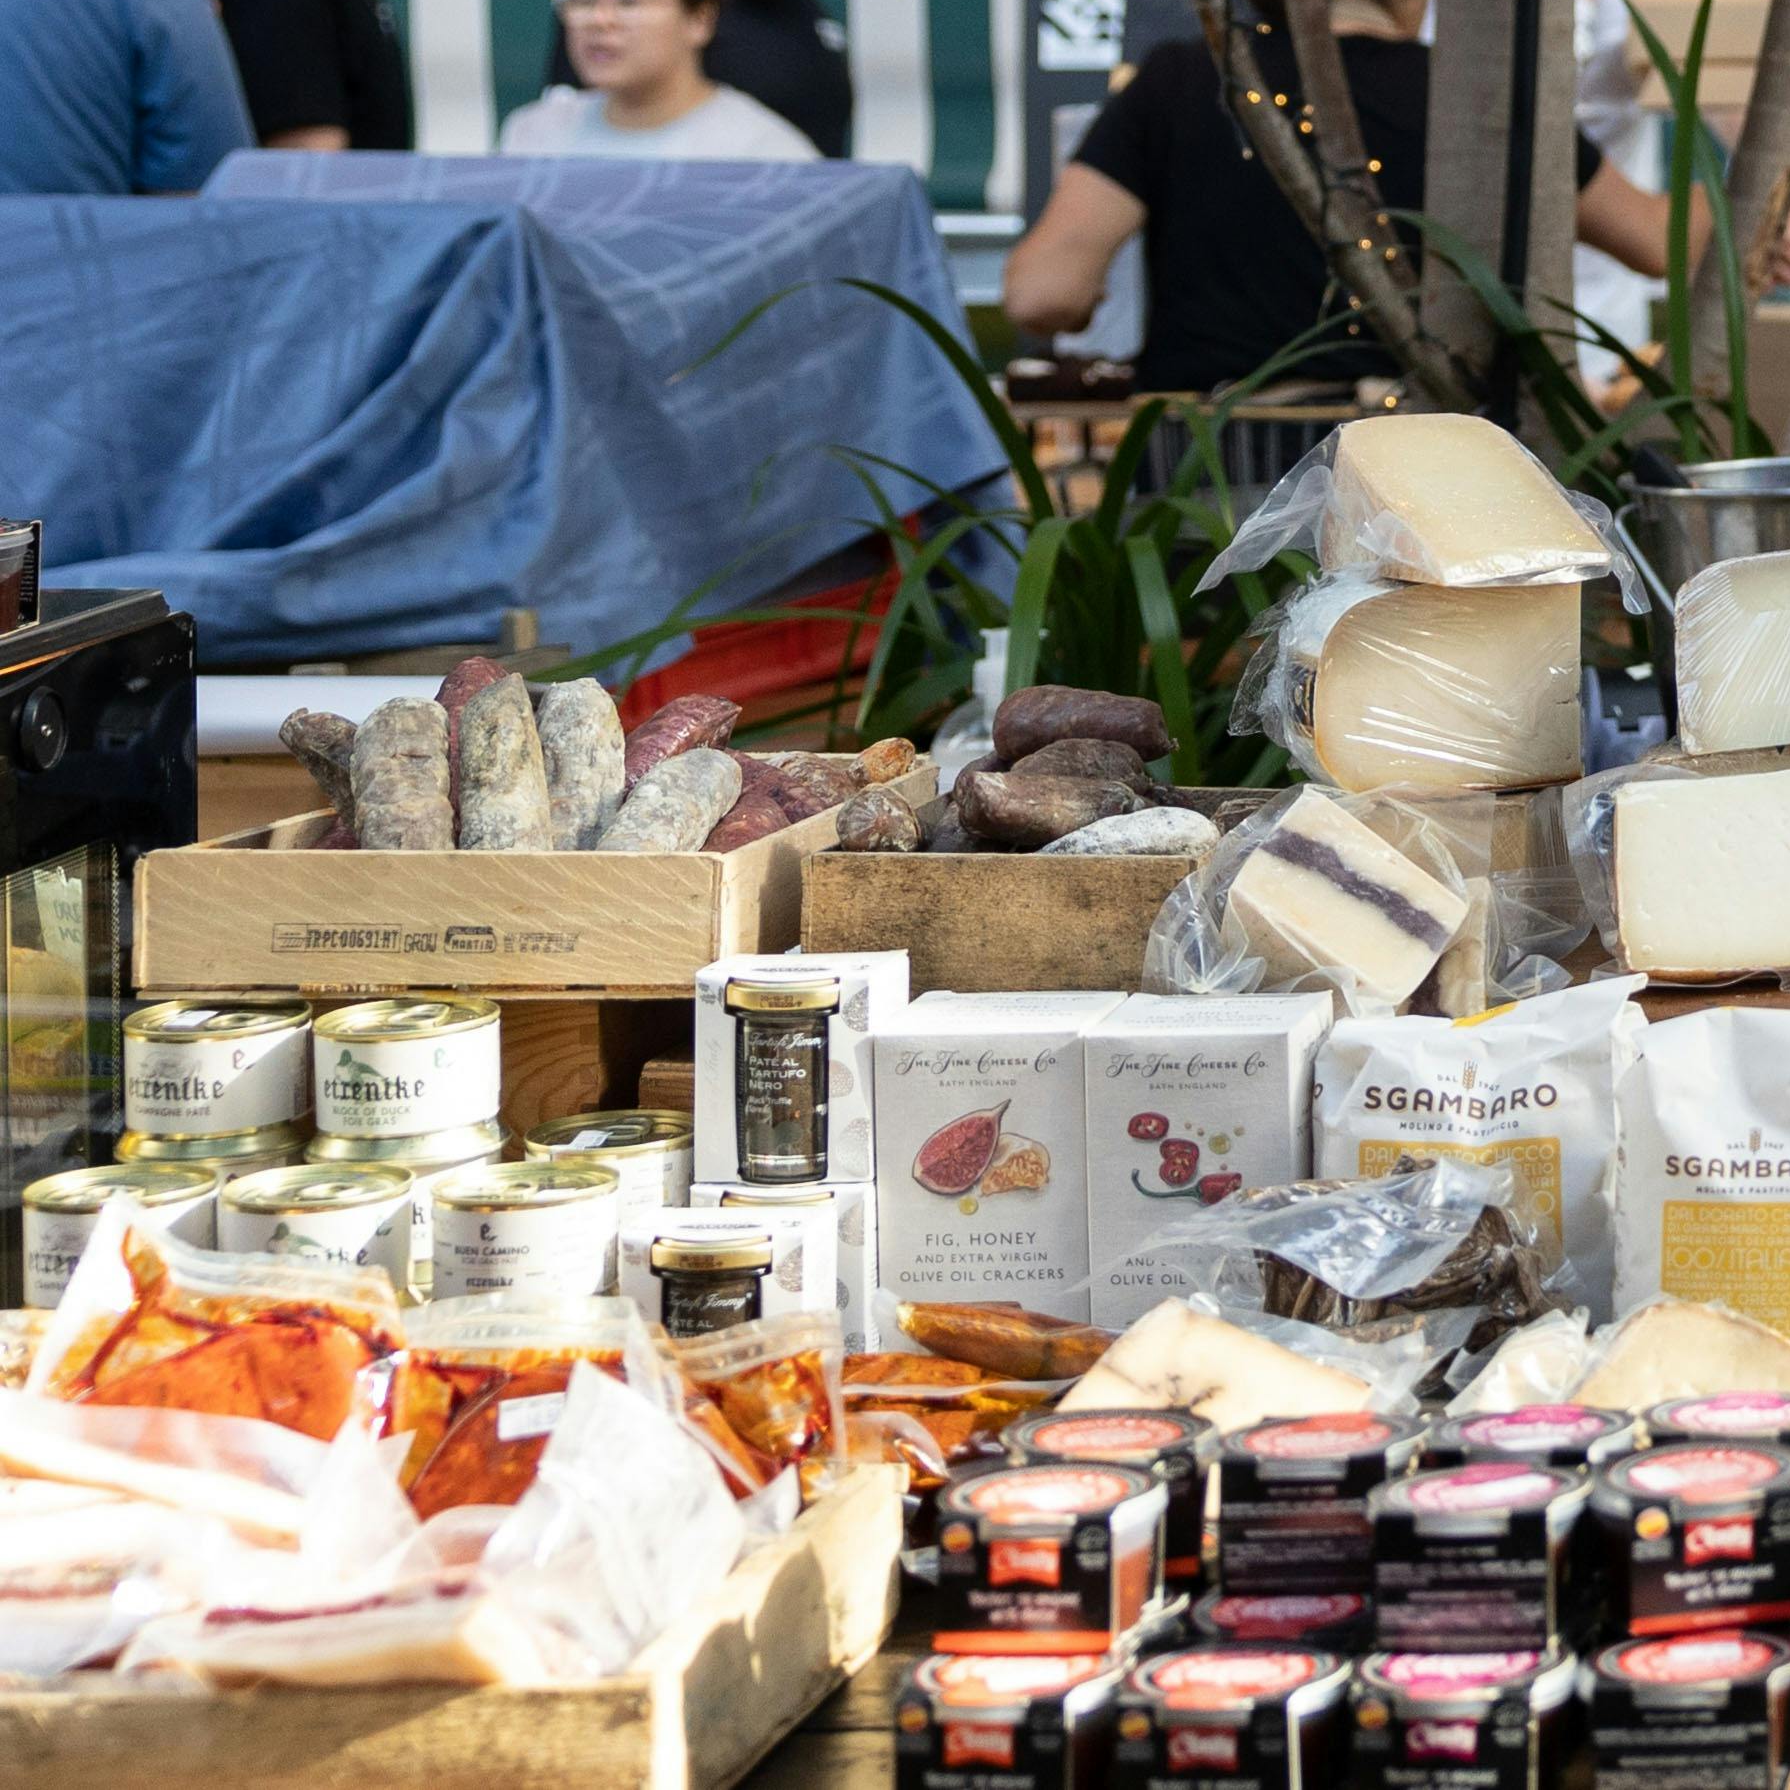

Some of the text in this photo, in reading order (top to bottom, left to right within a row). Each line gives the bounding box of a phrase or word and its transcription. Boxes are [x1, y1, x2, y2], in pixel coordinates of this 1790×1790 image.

[931, 1050, 1029, 1074] FINE CHEESE
[1141, 1052, 1239, 1077] FINE CHEESE
[749, 1067, 806, 1079] TARTUFO
[749, 1079, 782, 1091] NERO
[1364, 1083, 1558, 1121] SGAMBARO
[381, 1105, 410, 1115] DUCK
[1400, 1121, 1442, 1132] MOLINO
[925, 1231, 1037, 1248] FIG, HONEY
[454, 1244, 481, 1257] BUEN
[915, 1251, 1048, 1264] AND EXTRA VIRGIN
[900, 1268, 1065, 1283] OLIVE OIL CRACKERS
[1110, 1273, 1187, 1286] OLIVE OIL
